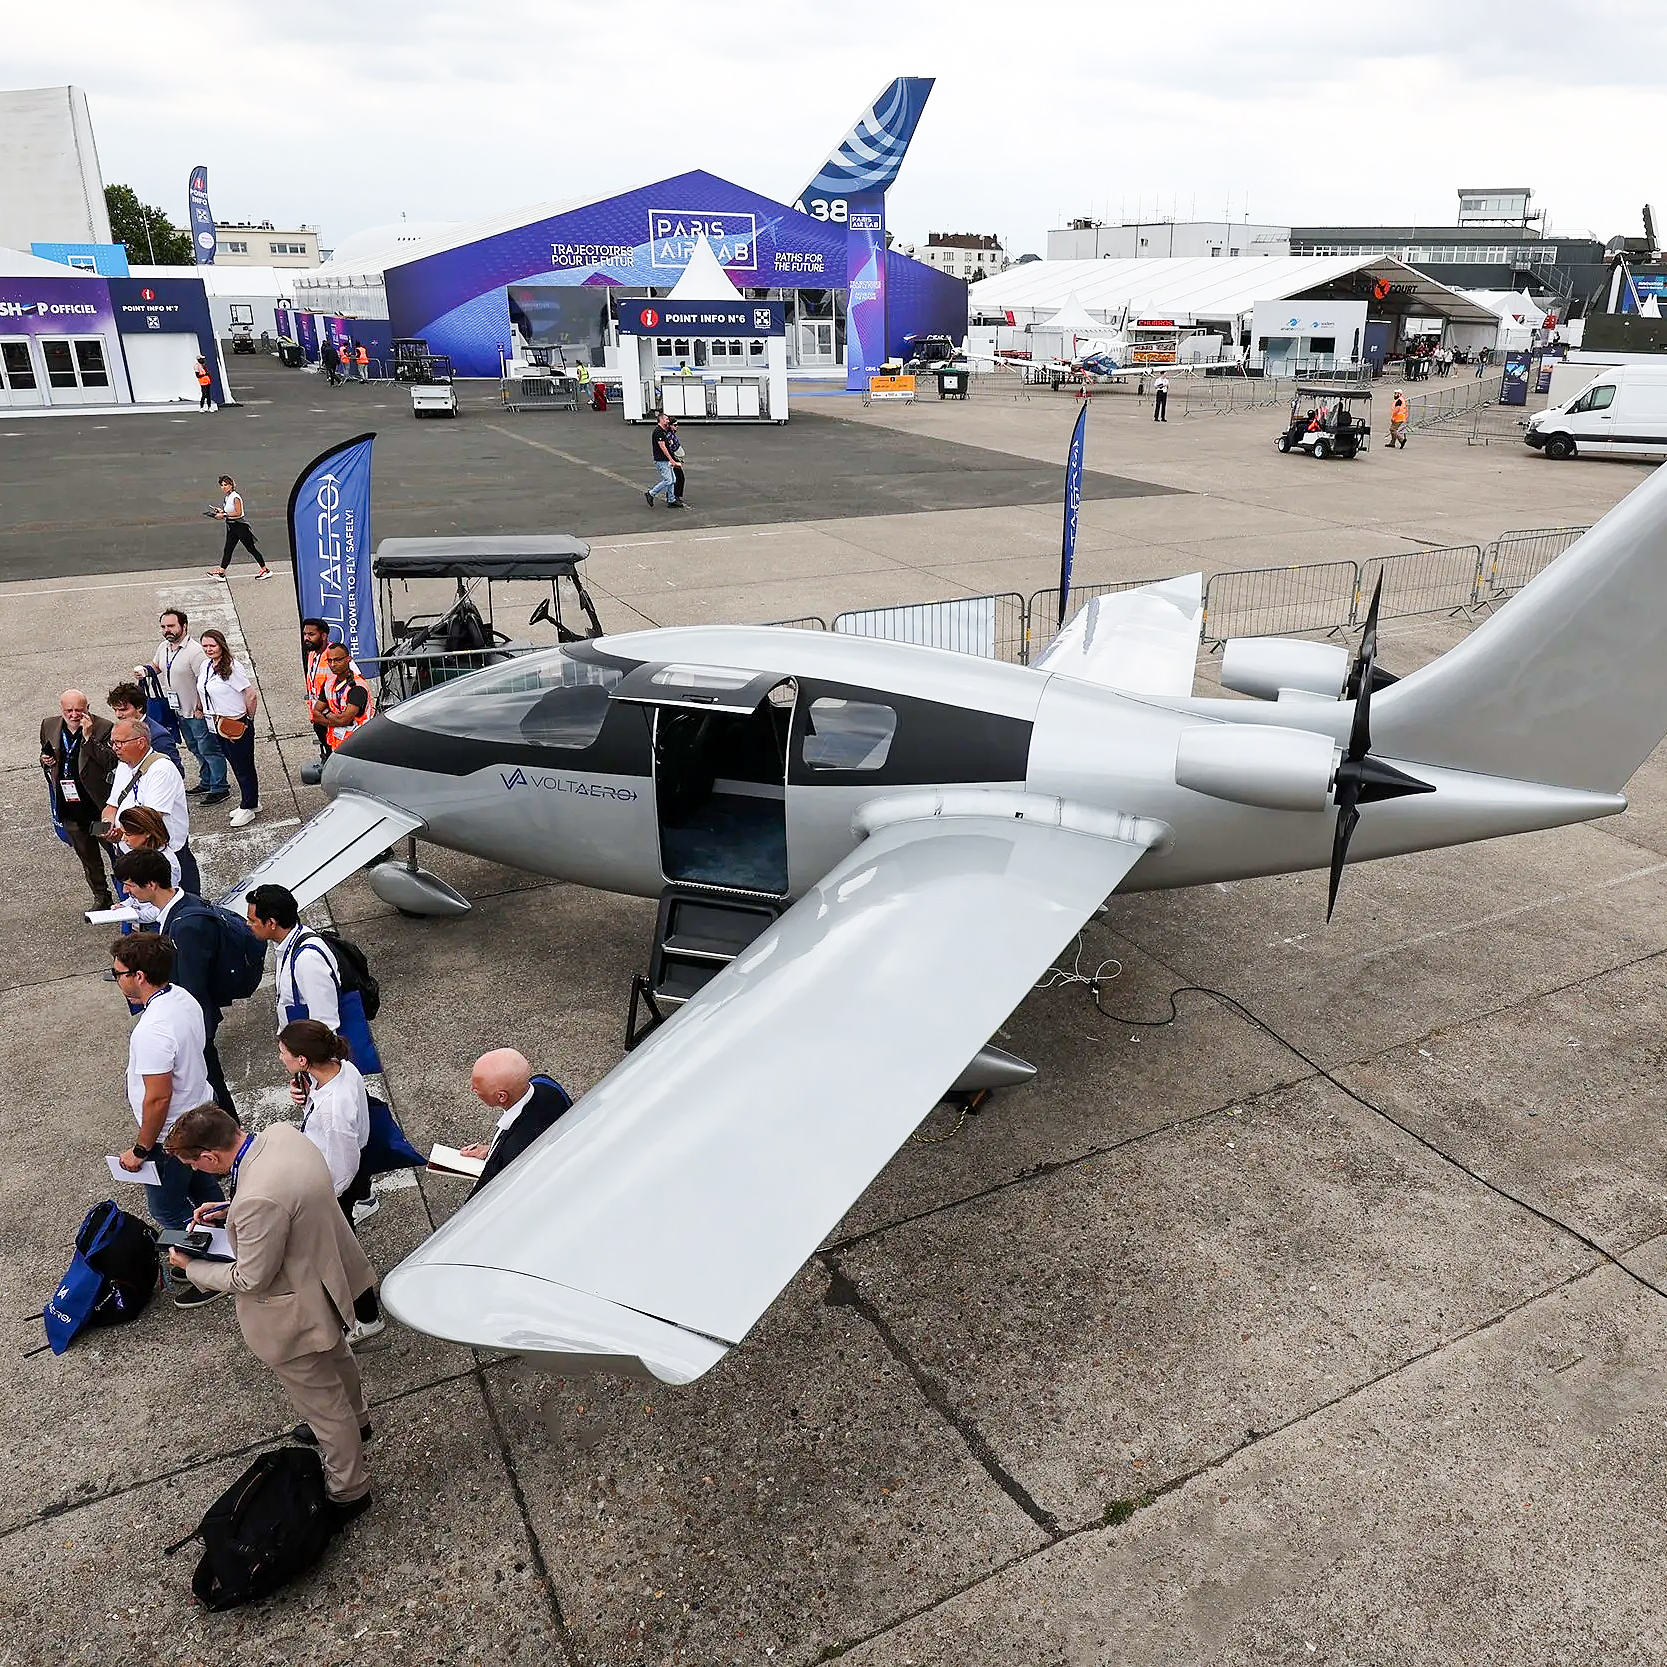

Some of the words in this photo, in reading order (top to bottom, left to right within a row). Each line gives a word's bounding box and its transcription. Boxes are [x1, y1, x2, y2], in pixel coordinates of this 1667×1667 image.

[793, 199, 848, 223] A38
[657, 218, 725, 240] PARIS
[550, 243, 634, 257] TRAJECTOIRES
[660, 240, 696, 259] AIR
[717, 243, 750, 261] AB
[775, 252, 803, 262] PATHS
[804, 253, 823, 263] FOR
[551, 255, 583, 266] POUR
[585, 255, 598, 266] LE
[600, 256, 634, 267] FUTUR
[774, 262, 790, 271] THE
[791, 262, 825, 272] FUTURE
[1389, 284, 1418, 294] COURT
[50, 304, 98, 315] OFFICIEL
[665, 313, 698, 323] POINT
[700, 314, 726, 323] INFO
[728, 314, 746, 323] N°6
[346, 509, 355, 553] SAFELY!
[317, 481, 346, 645] OLTAERO
[346, 555, 356, 574] FLY
[346, 576, 356, 591] TO
[347, 593, 358, 634] POWER
[349, 636, 360, 656] THE
[531, 775, 635, 801] VOLTAERO
